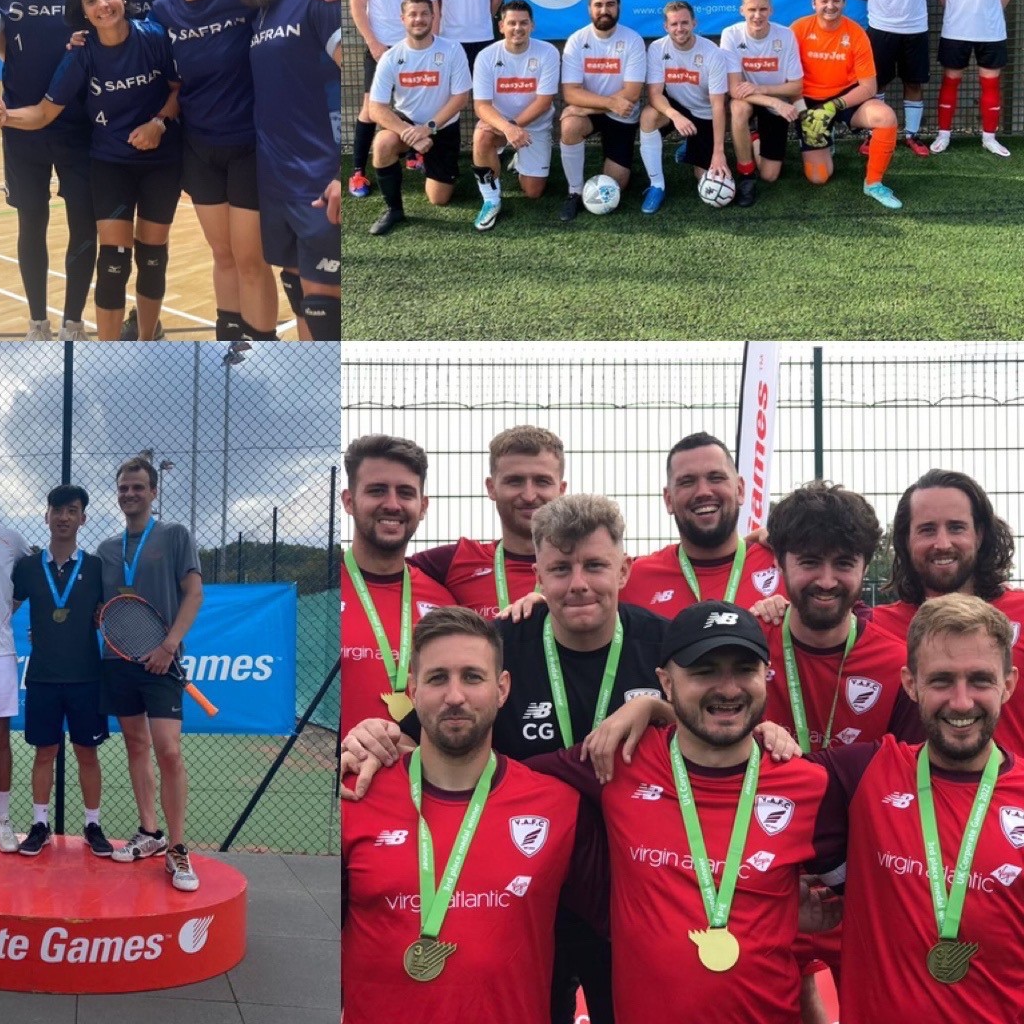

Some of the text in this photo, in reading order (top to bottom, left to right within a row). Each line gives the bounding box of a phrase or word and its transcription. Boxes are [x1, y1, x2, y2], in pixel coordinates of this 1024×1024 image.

[14, 33, 23, 51] 1
[743, 60, 776, 70] easyJet
[807, 51, 846, 61] easyJet
[586, 61, 618, 70] easyJet
[402, 75, 437, 84] easyJet
[500, 80, 535, 89] easyJet
[96, 109, 108, 126] 4
[180, 653, 274, 681] ames
[523, 702, 553, 719] NB
[523, 722, 554, 740] CG
[442, 802, 481, 891] 3rd place medal winner
[959, 828, 978, 870] Corporate
[630, 844, 678, 868] virgin
[878, 851, 923, 875] virgin
[385, 889, 511, 912] virg atlantic
[40, 926, 164, 964] Games
